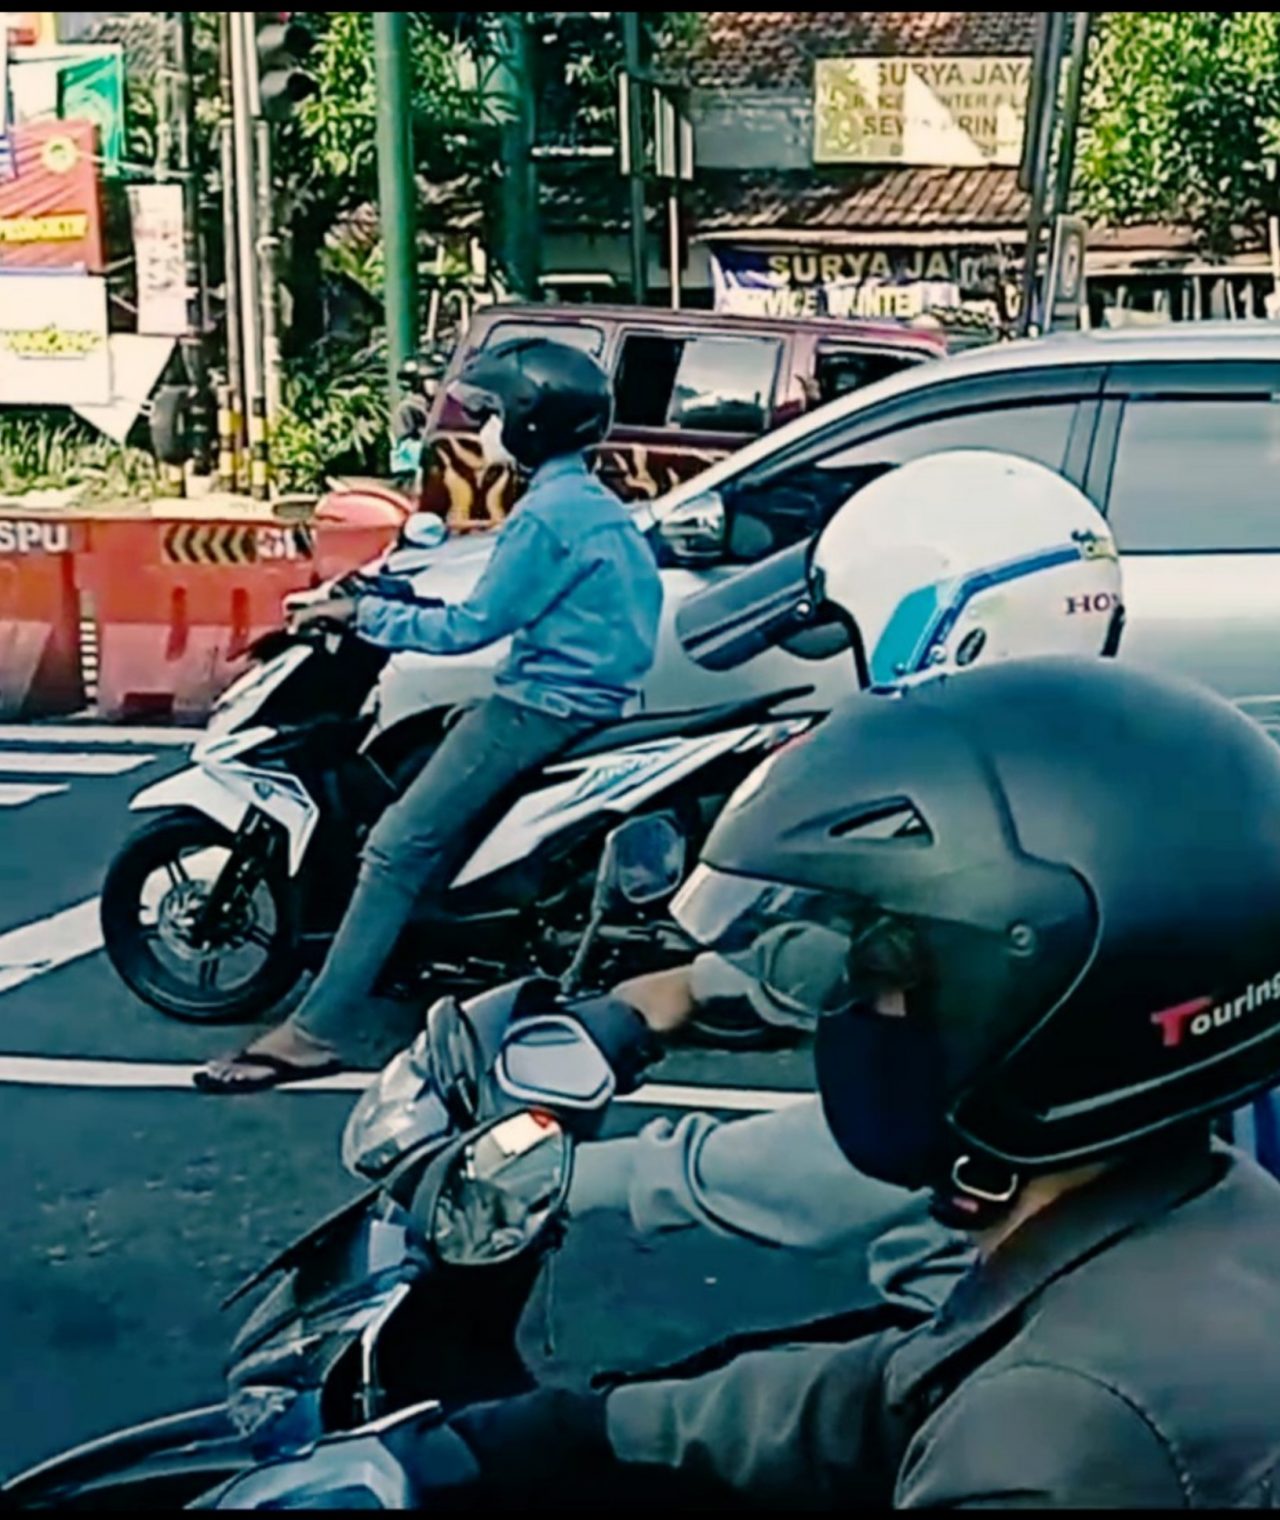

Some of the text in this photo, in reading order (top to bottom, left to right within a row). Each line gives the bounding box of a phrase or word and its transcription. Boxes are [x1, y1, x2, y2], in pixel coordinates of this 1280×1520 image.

[877, 62, 964, 85] SURYA
[768, 251, 892, 283] SURYA
[905, 252, 957, 281] JA
